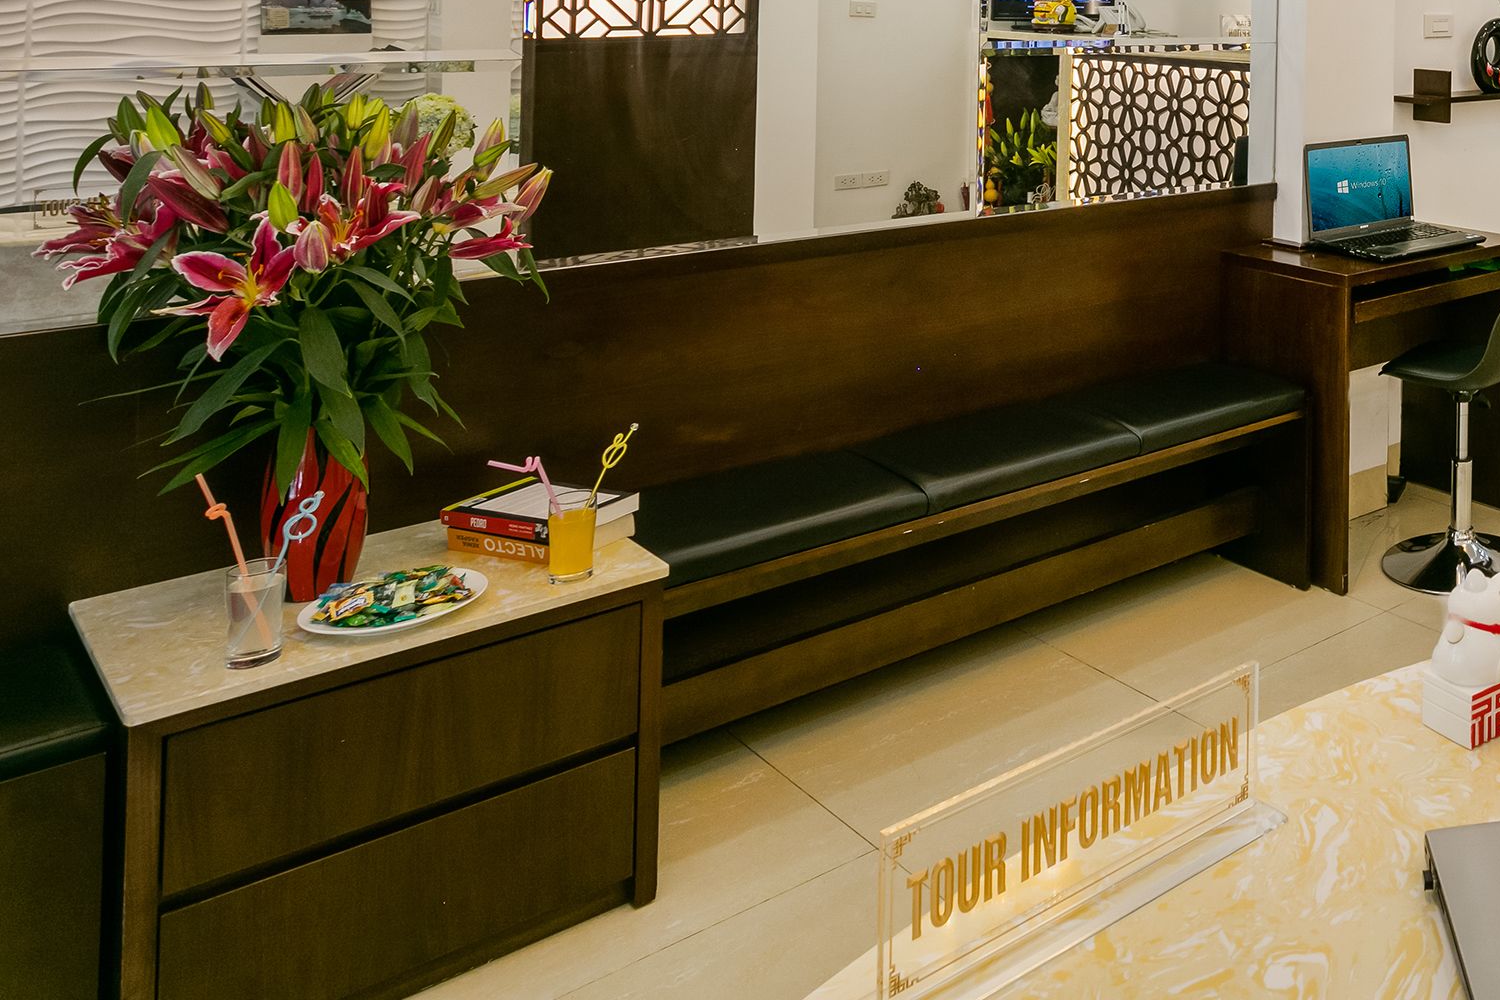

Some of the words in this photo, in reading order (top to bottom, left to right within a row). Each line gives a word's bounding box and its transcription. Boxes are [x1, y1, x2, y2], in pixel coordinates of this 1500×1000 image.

[1350, 181, 1378, 189] Windows
[470, 517, 487, 529] PEDRO
[484, 538, 545, 559] ALECTO
[907, 831, 1006, 941] TOUR
[1021, 716, 1240, 883] INFORMATION
